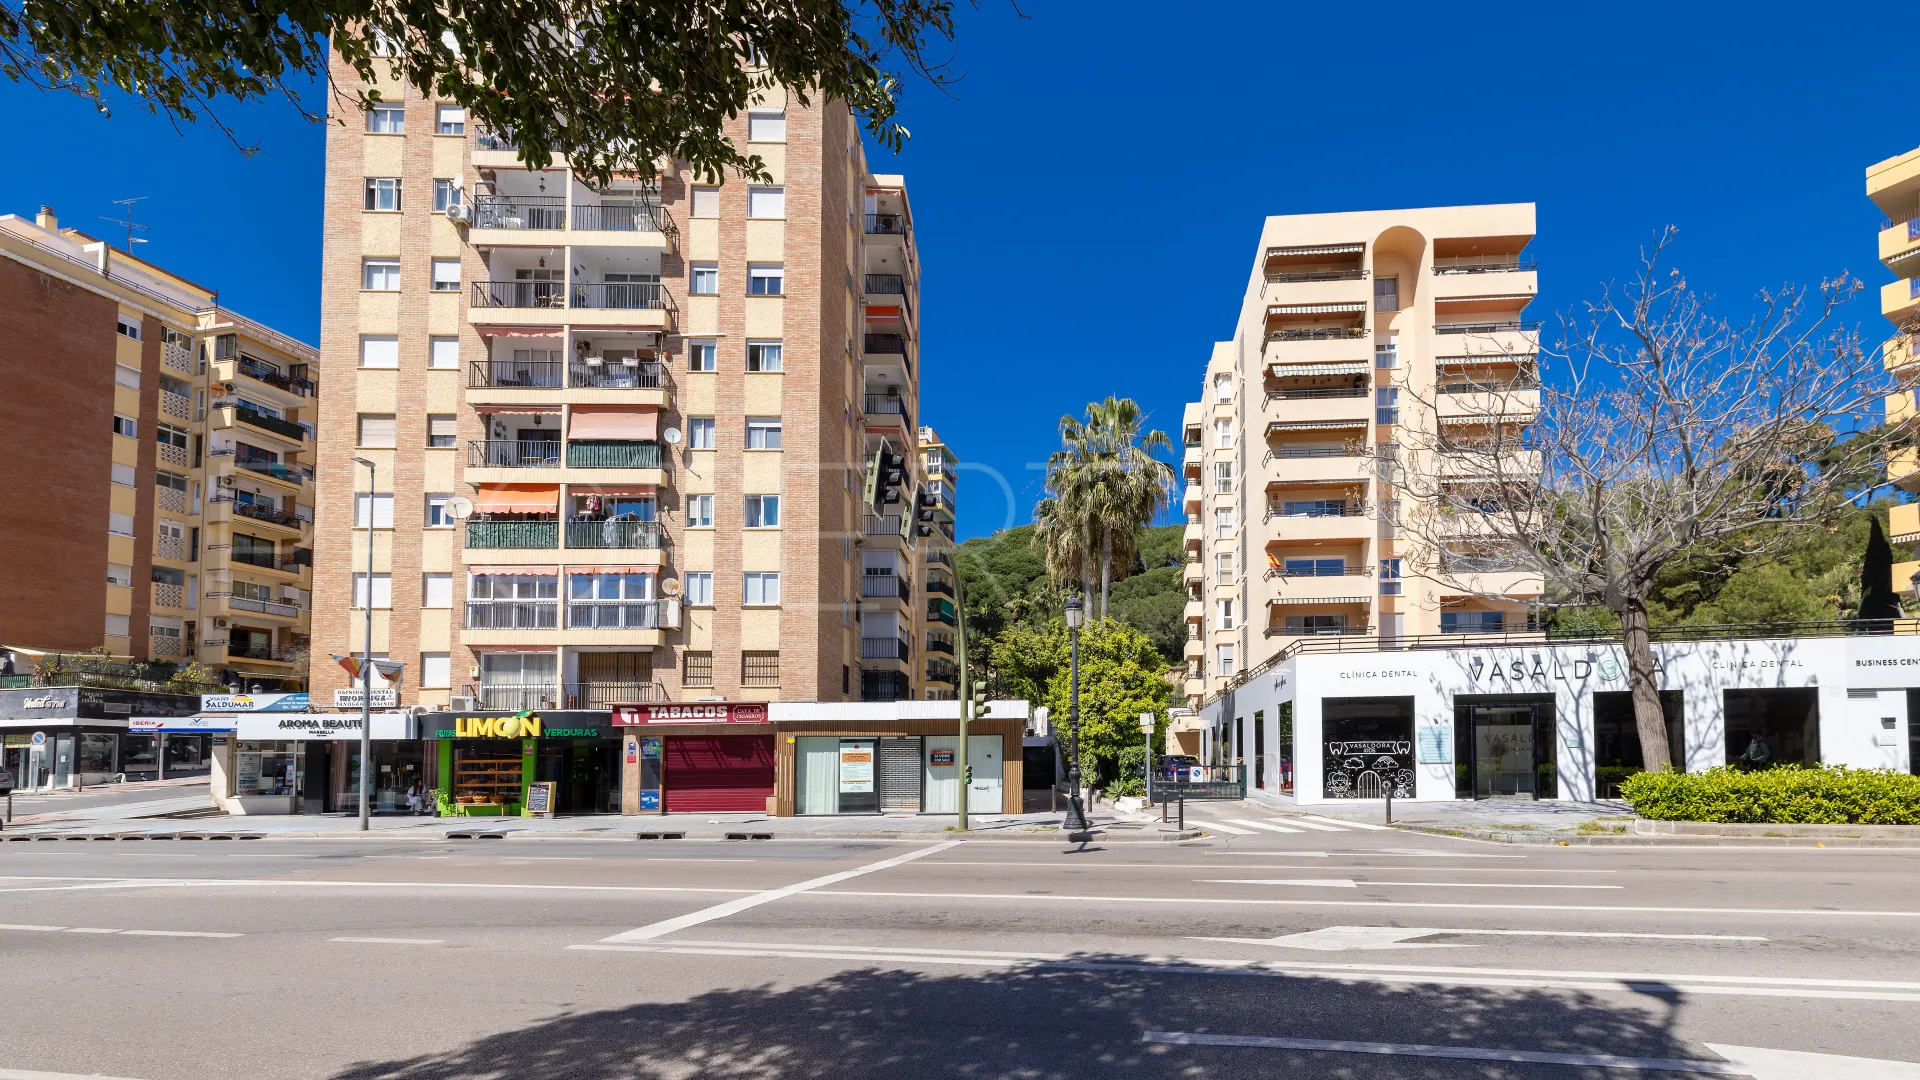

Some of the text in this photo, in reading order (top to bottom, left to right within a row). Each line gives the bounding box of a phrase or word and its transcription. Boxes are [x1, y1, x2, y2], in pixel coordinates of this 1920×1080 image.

[1761, 660, 1803, 668] DENTAL
[1856, 659, 1898, 667] BUSINESS
[1381, 670, 1418, 678] DENTAL
[205, 699, 254, 709] SALDUMAR
[648, 705, 728, 719] TABACOS
[278, 719, 321, 729] AROMA
[435, 729, 456, 738] FRUTAS
[544, 728, 598, 737] VERDURAS
